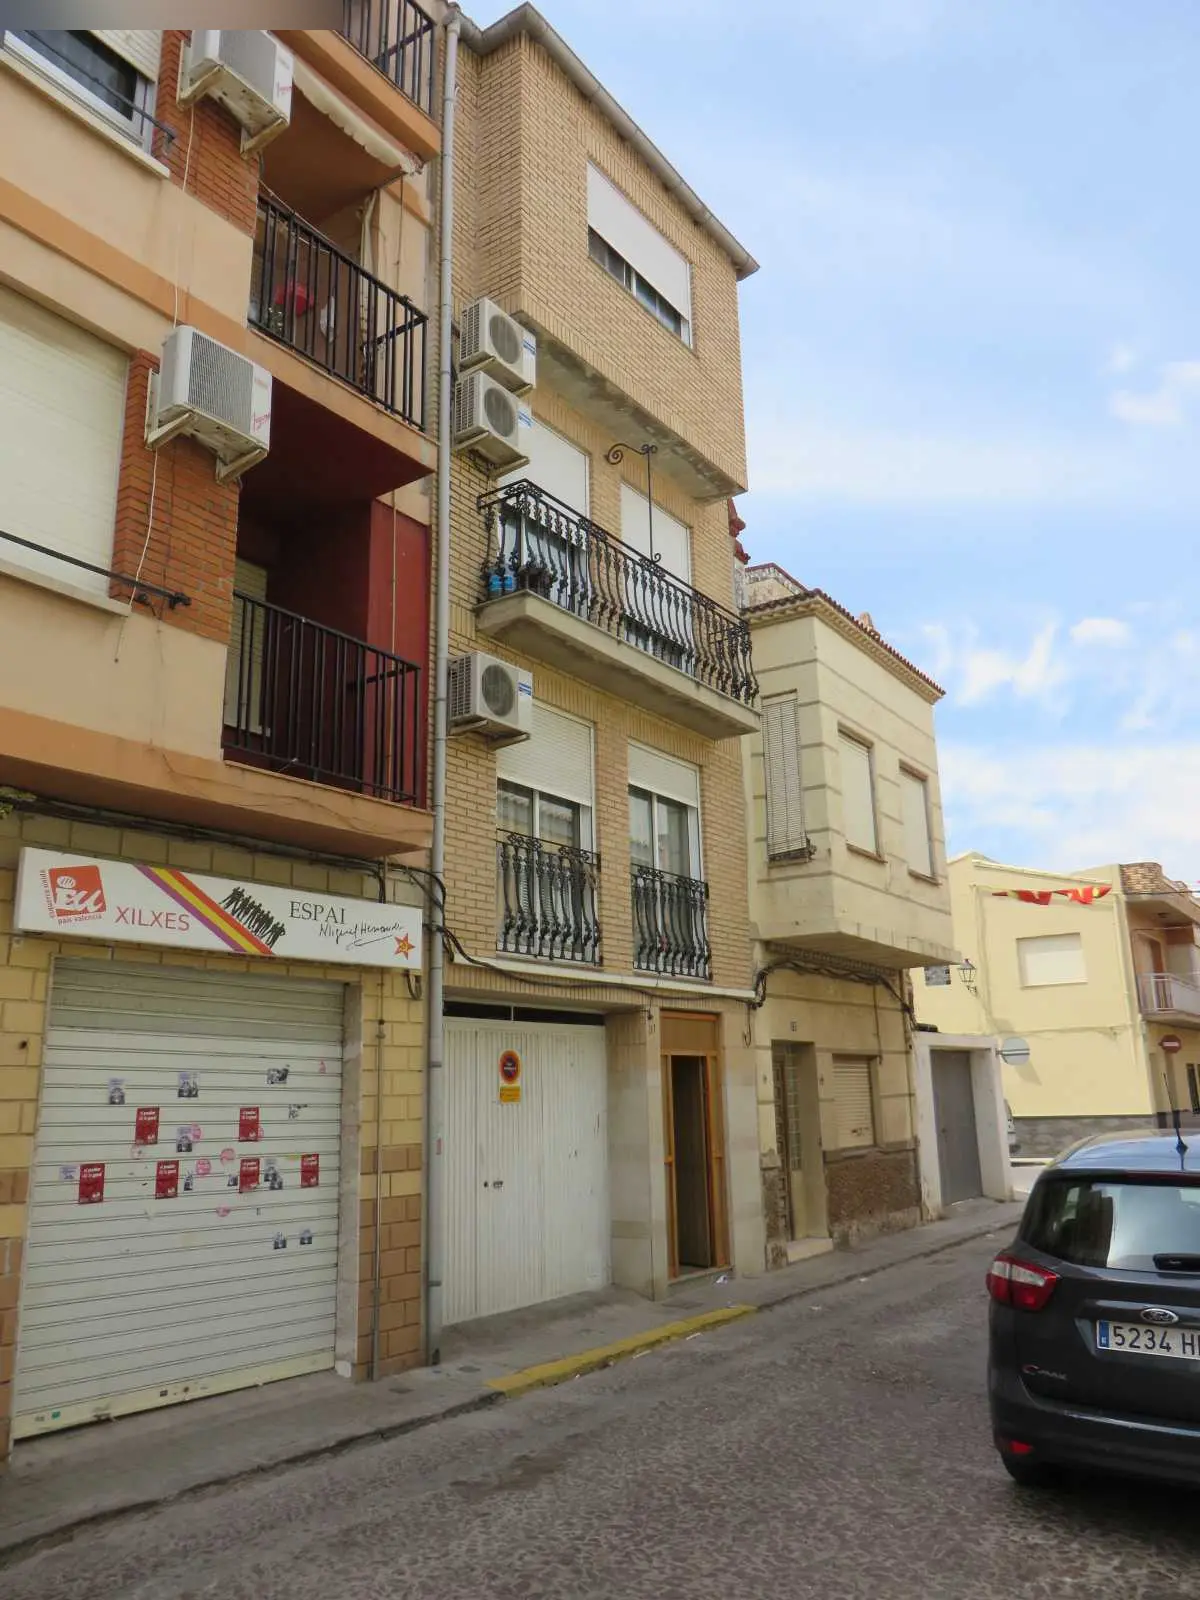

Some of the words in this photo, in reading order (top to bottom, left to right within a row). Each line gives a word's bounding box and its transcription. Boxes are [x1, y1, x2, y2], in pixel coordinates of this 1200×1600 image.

[114, 905, 190, 931] XILXES
[289, 900, 347, 925] ESPAI
[1112, 1325, 1172, 1353] 5234
[1181, 1332, 1200, 1356] H
